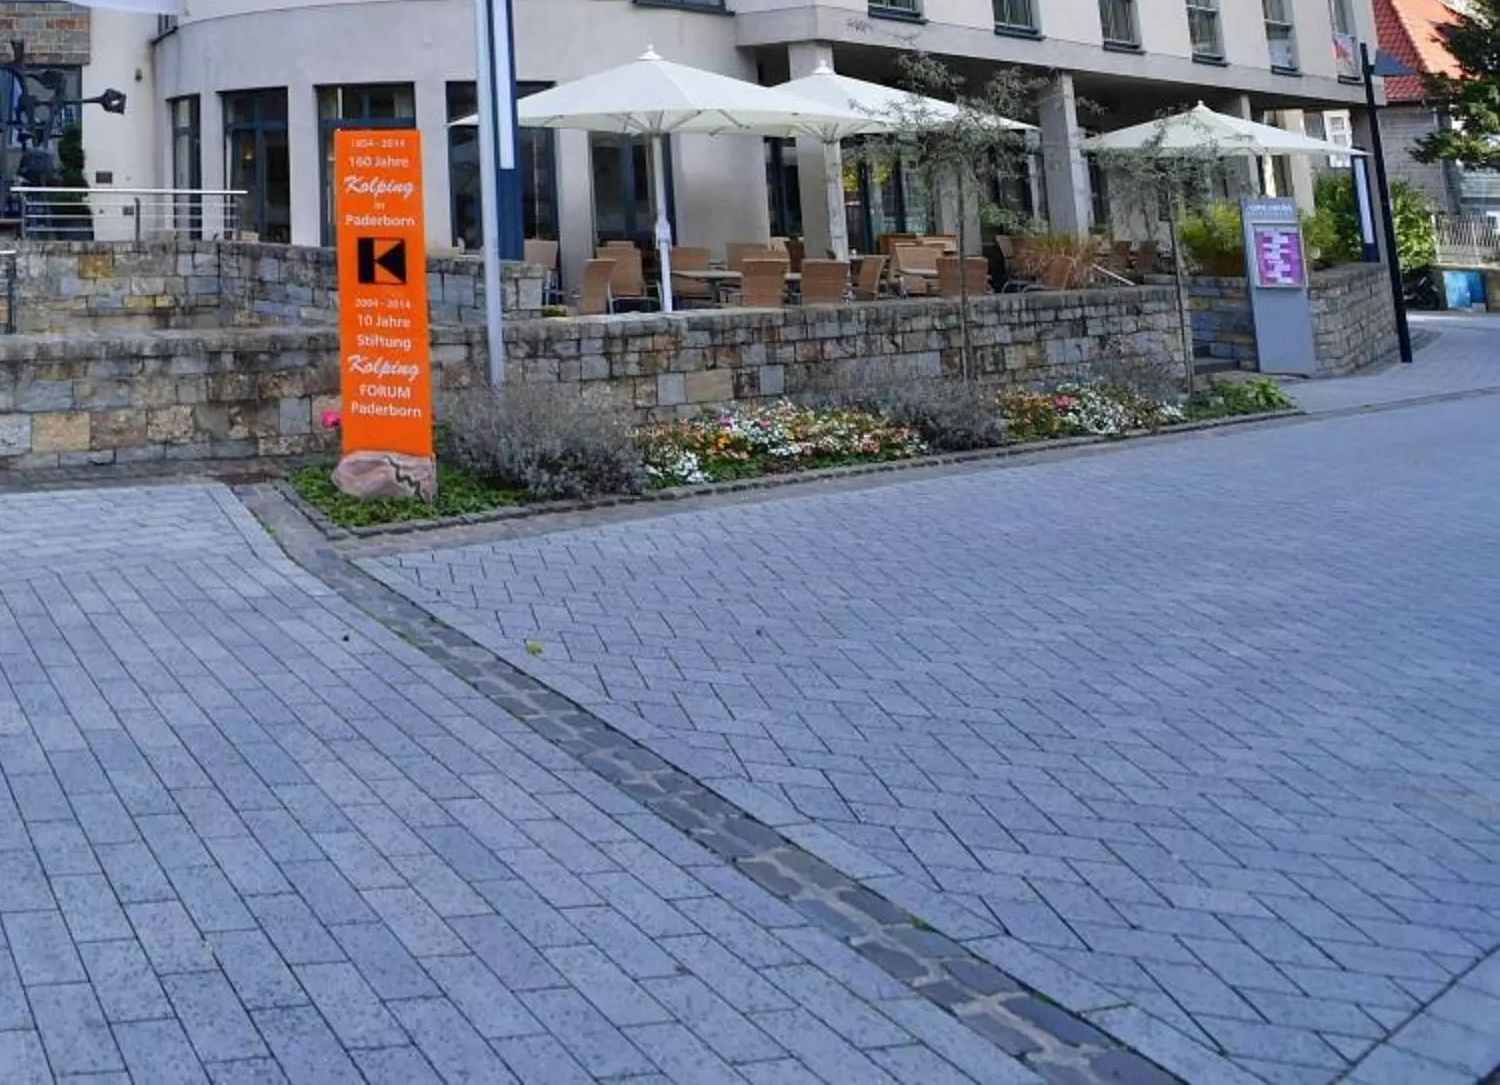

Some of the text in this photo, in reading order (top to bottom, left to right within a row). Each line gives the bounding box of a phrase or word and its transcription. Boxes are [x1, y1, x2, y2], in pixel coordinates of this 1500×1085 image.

[349, 155, 410, 168] 160 Jahre
[343, 173, 414, 200] Kolping
[344, 213, 416, 227] Paderborn
[357, 314, 411, 329] 10 Jahre
[356, 334, 412, 352] Stiftung
[347, 354, 420, 383] Kolping
[359, 383, 412, 400] FORUM
[351, 401, 422, 419] Paderborn
